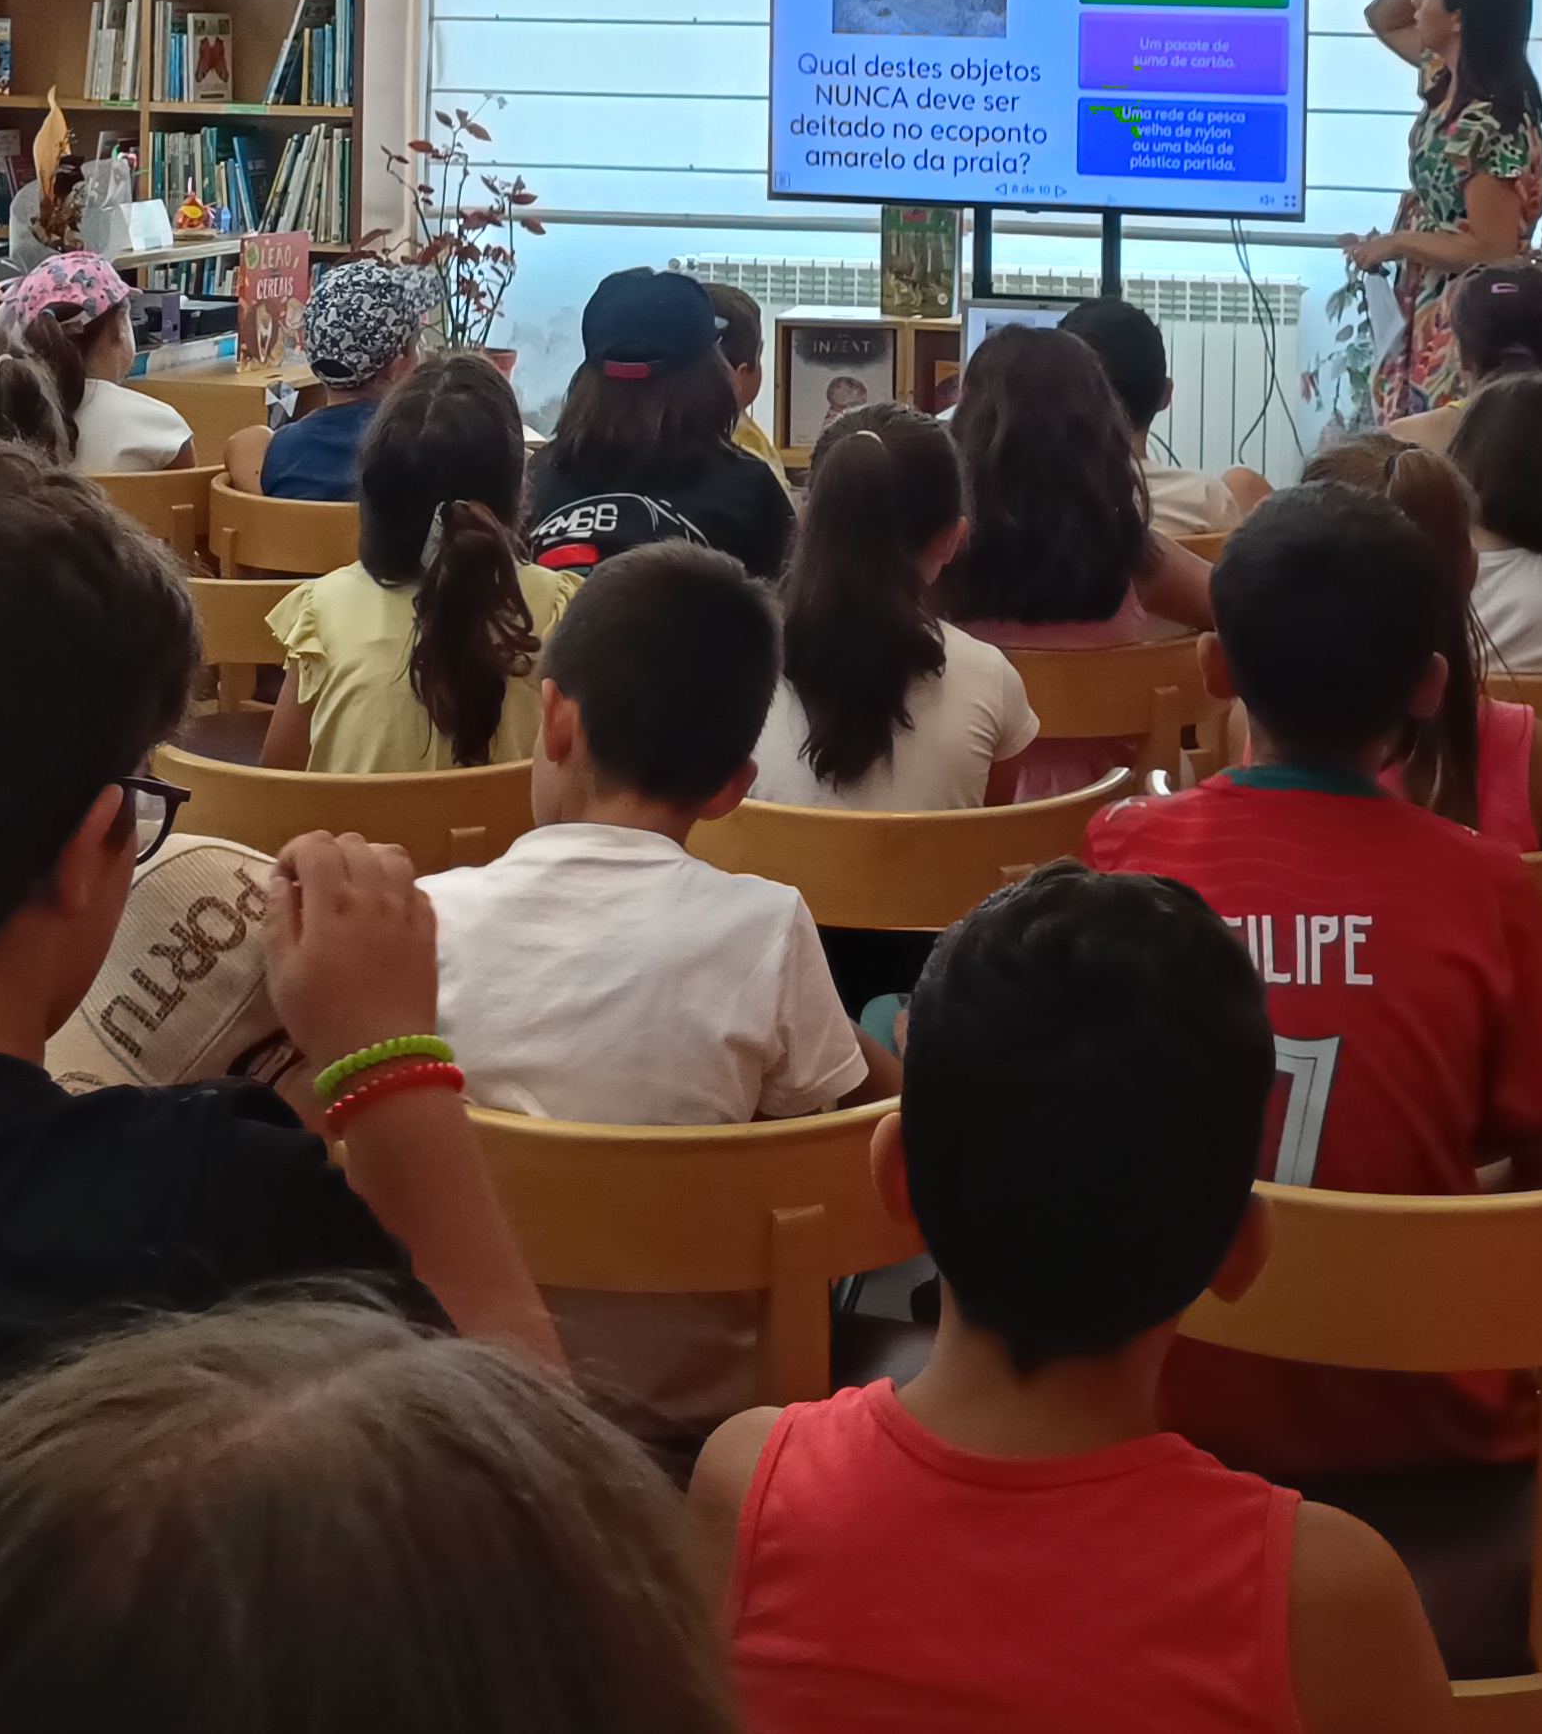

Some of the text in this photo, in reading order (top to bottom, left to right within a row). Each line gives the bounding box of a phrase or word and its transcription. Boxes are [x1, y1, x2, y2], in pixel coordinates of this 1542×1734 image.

[1139, 37, 1230, 54] Um pacote de
[797, 52, 1042, 87] Qual destes objetos
[1133, 55, 1168, 68] sumo
[1170, 55, 1188, 68] de
[815, 83, 1020, 113] NUNCA deve ser
[1122, 106, 1246, 126] Uma rede de pesca
[790, 113, 1048, 148] deitado no ecoponto
[1136, 123, 1231, 142] velha de nylon
[1132, 141, 1150, 152] ou
[1153, 141, 1181, 154] uma
[1217, 141, 1234, 156] de
[805, 145, 1031, 178] amarelo da praia?
[1130, 154, 1236, 172] plástico partida.
[1021, 184, 1035, 195] de
[1039, 185, 1051, 196] 10
[256, 276, 294, 300] CEREAIS
[1228, 914, 1373, 986] ILIPE
